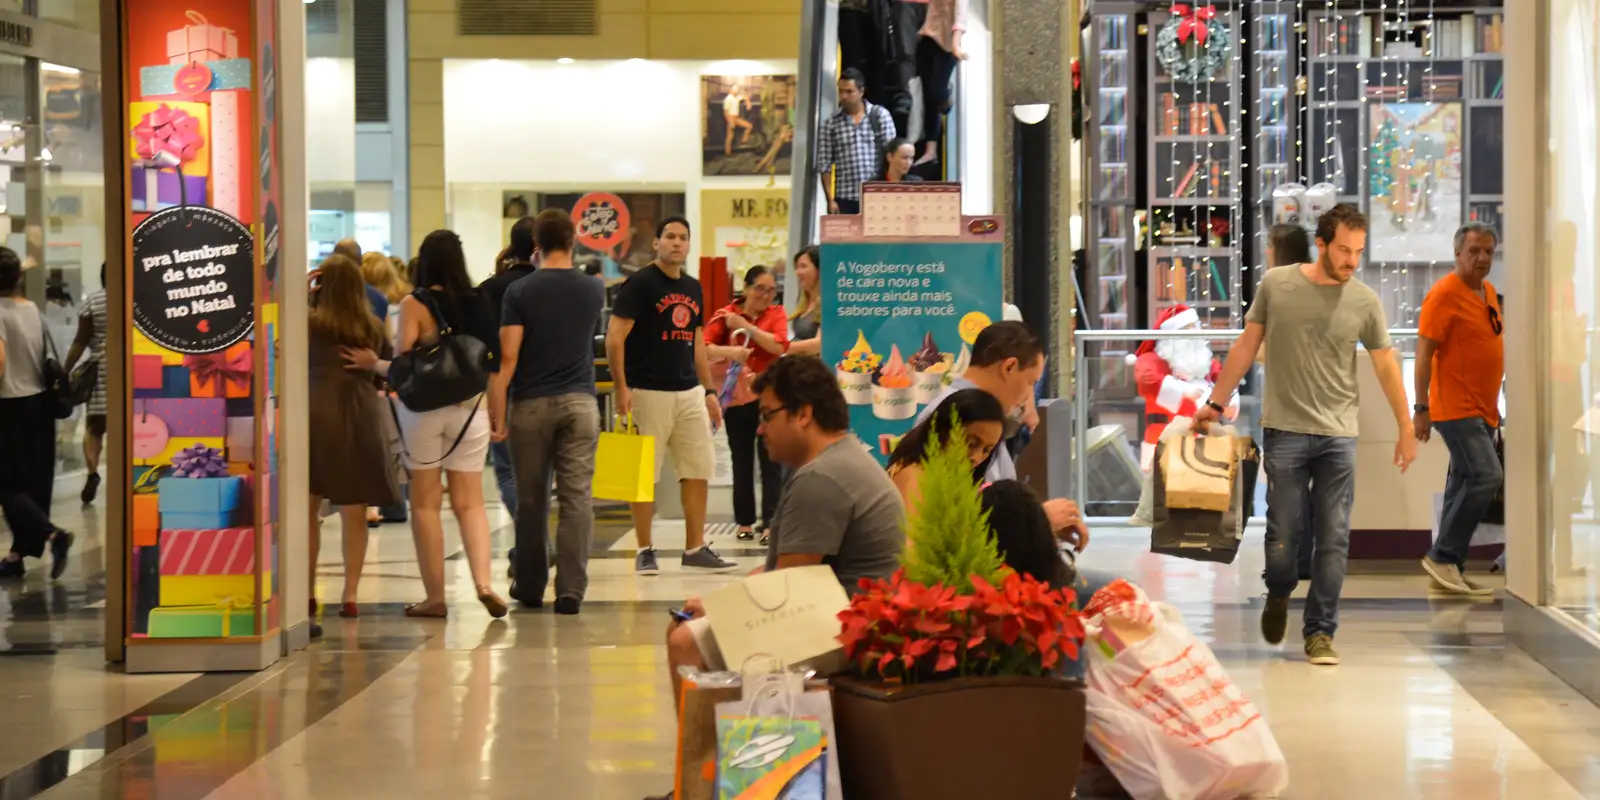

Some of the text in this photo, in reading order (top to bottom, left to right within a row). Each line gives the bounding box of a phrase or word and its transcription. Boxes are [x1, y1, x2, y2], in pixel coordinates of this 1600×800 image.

[142, 244, 239, 272] pra lembrar
[162, 262, 226, 283] de todo
[836, 260, 945, 276] A Yogoberry está
[166, 280, 228, 300] mundo
[837, 276, 931, 288] de cara nova e
[837, 290, 953, 302] trouxe ainda mais
[165, 305, 189, 319] no
[191, 295, 237, 315] Natal
[837, 303, 958, 318] sabores para você.
